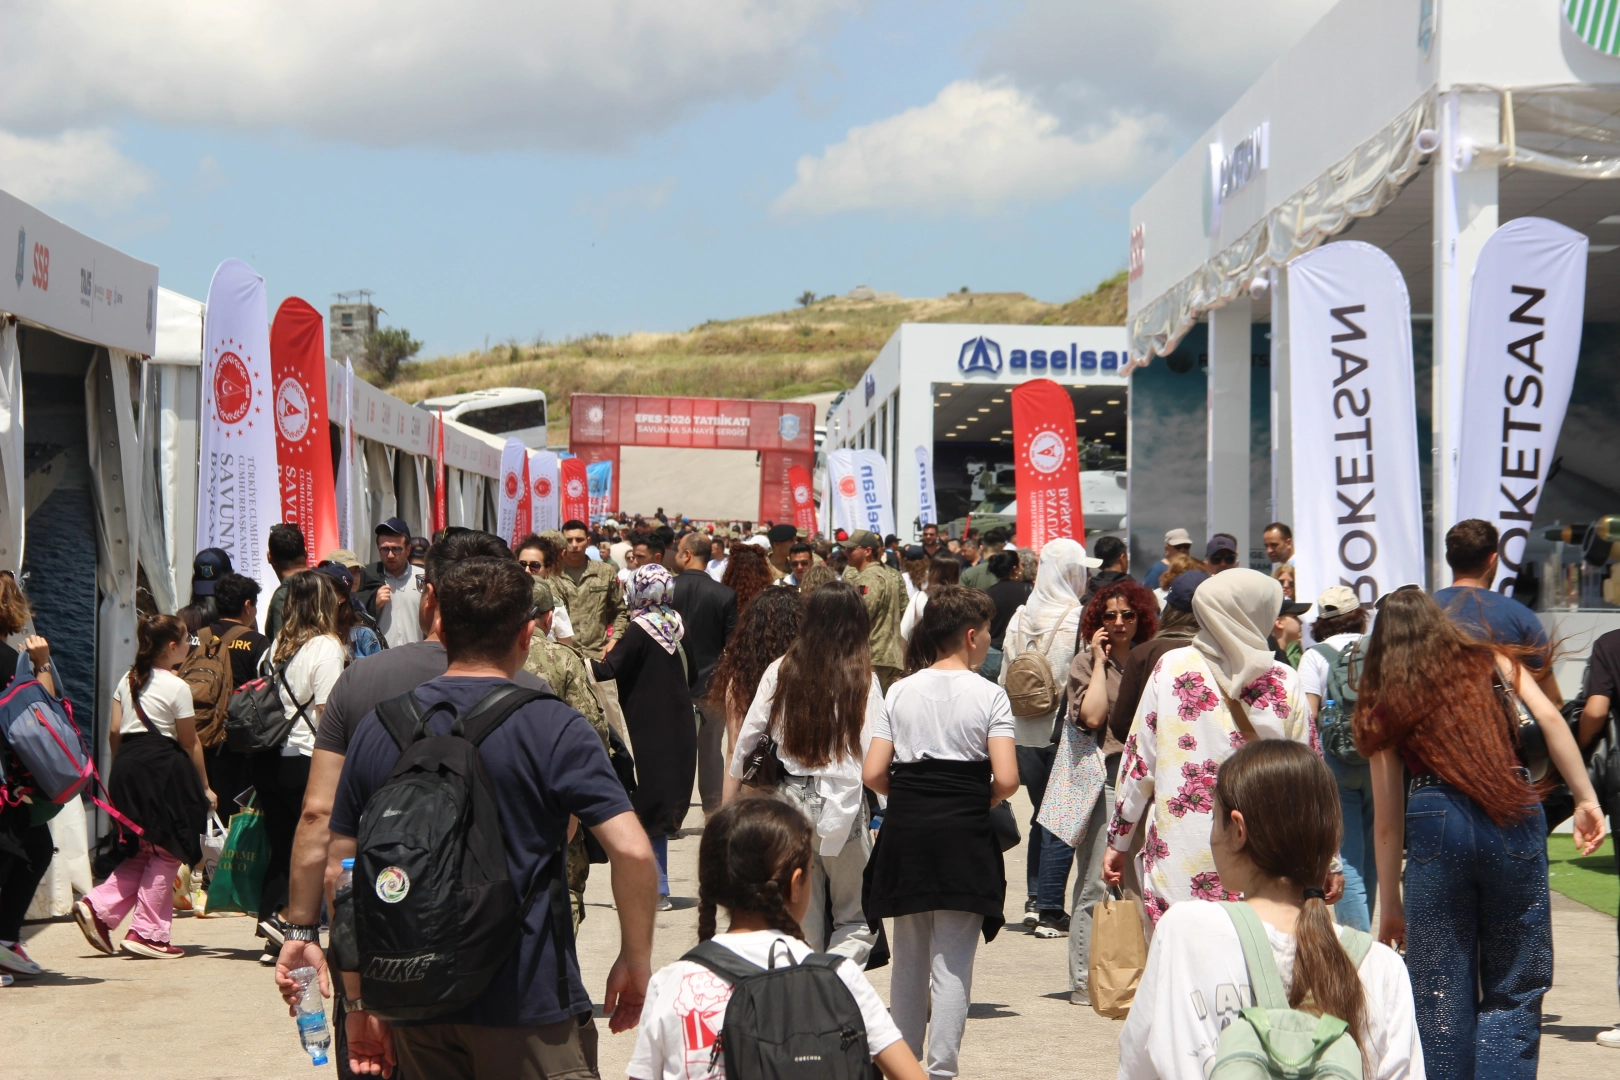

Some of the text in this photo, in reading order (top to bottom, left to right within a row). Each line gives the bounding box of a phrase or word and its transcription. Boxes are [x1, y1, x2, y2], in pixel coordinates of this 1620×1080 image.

[32, 241, 50, 292] SSB
[635, 413, 750, 427] EFES 2026 TATBİKATI
[637, 424, 680, 435] SAVUNMA
[247, 456, 258, 507] TÜRKİYE
[305, 470, 315, 514] TÜRKİYE
[238, 454, 250, 572] CUMHURBAŞKANLIĞI
[363, 952, 436, 983] NIKE
